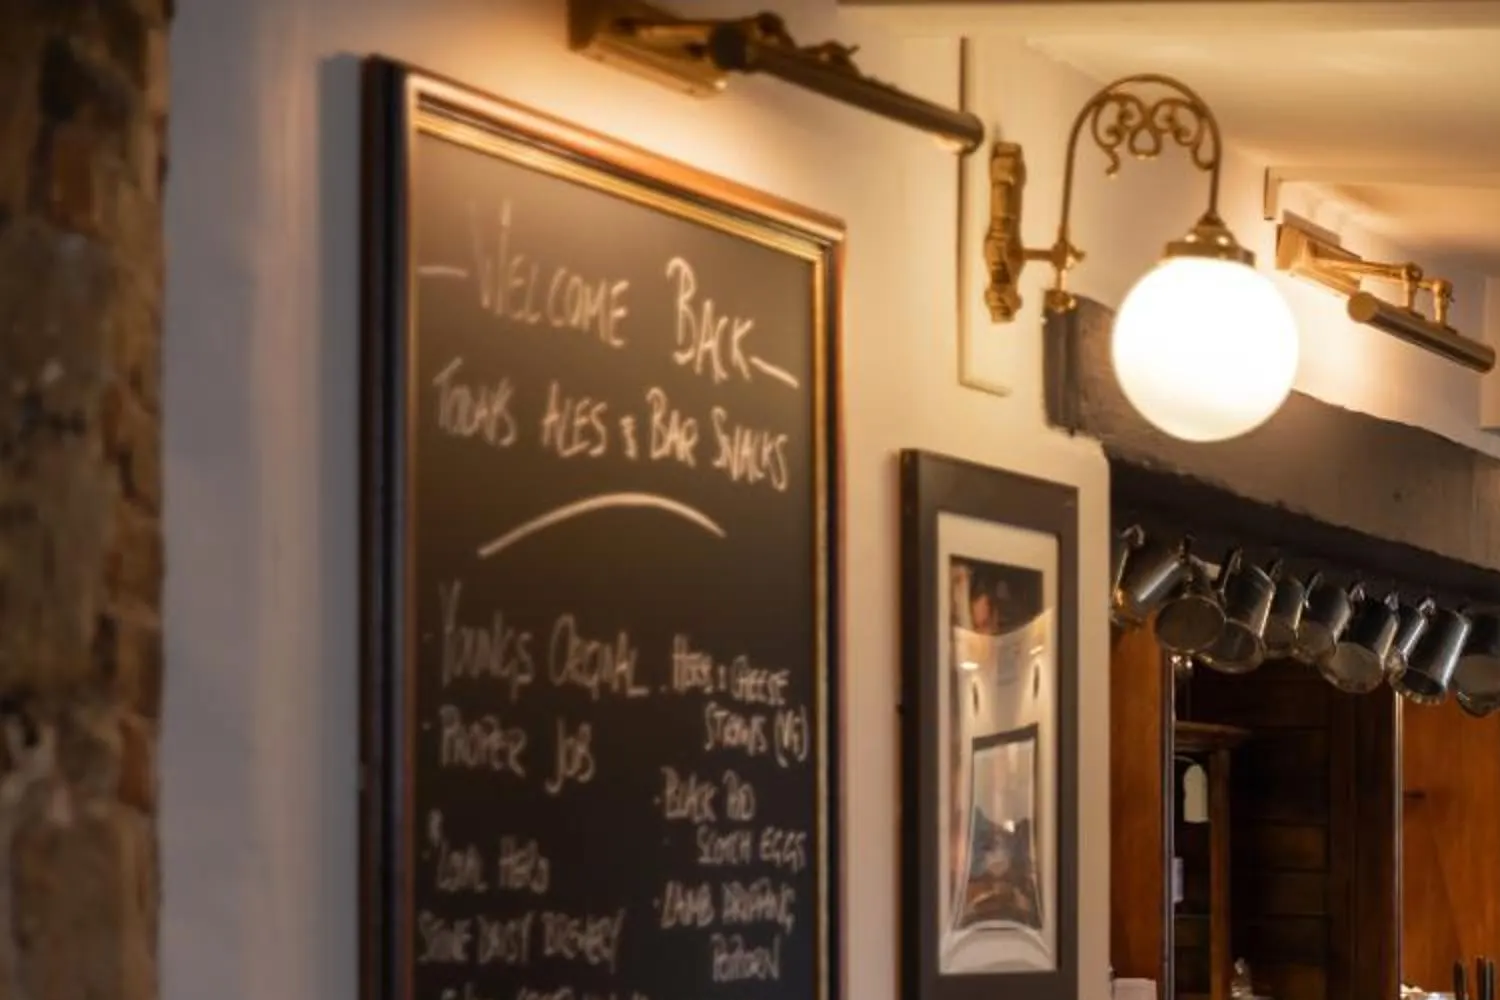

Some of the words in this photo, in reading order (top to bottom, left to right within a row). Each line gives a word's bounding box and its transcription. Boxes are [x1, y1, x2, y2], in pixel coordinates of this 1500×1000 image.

[471, 200, 630, 348] WELCOME
[667, 256, 755, 384] BACK
[541, 380, 609, 458] ALES
[646, 386, 700, 468] BAR
[710, 406, 789, 492] SNACKS
[545, 716, 597, 794] JOB
